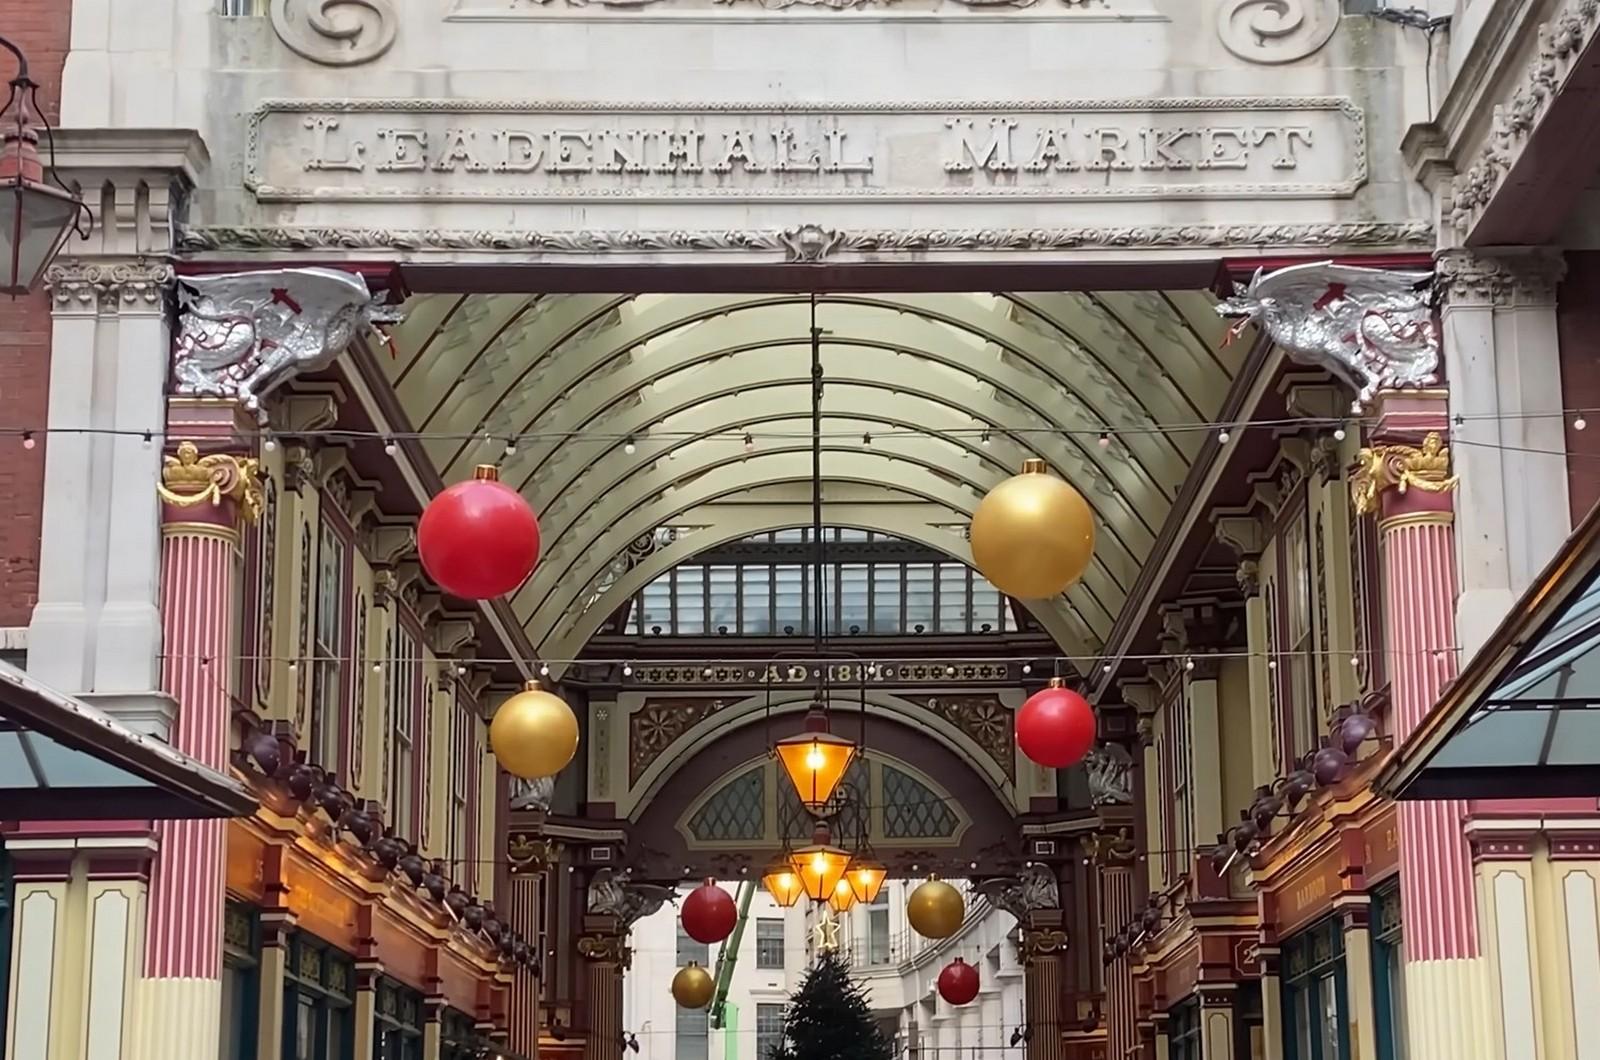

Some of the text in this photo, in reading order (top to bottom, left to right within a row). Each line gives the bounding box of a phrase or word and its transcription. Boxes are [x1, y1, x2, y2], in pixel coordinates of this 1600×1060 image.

[303, 116, 1313, 174] LEADENHALL MARKET
[824, 664, 885, 682] 1881
